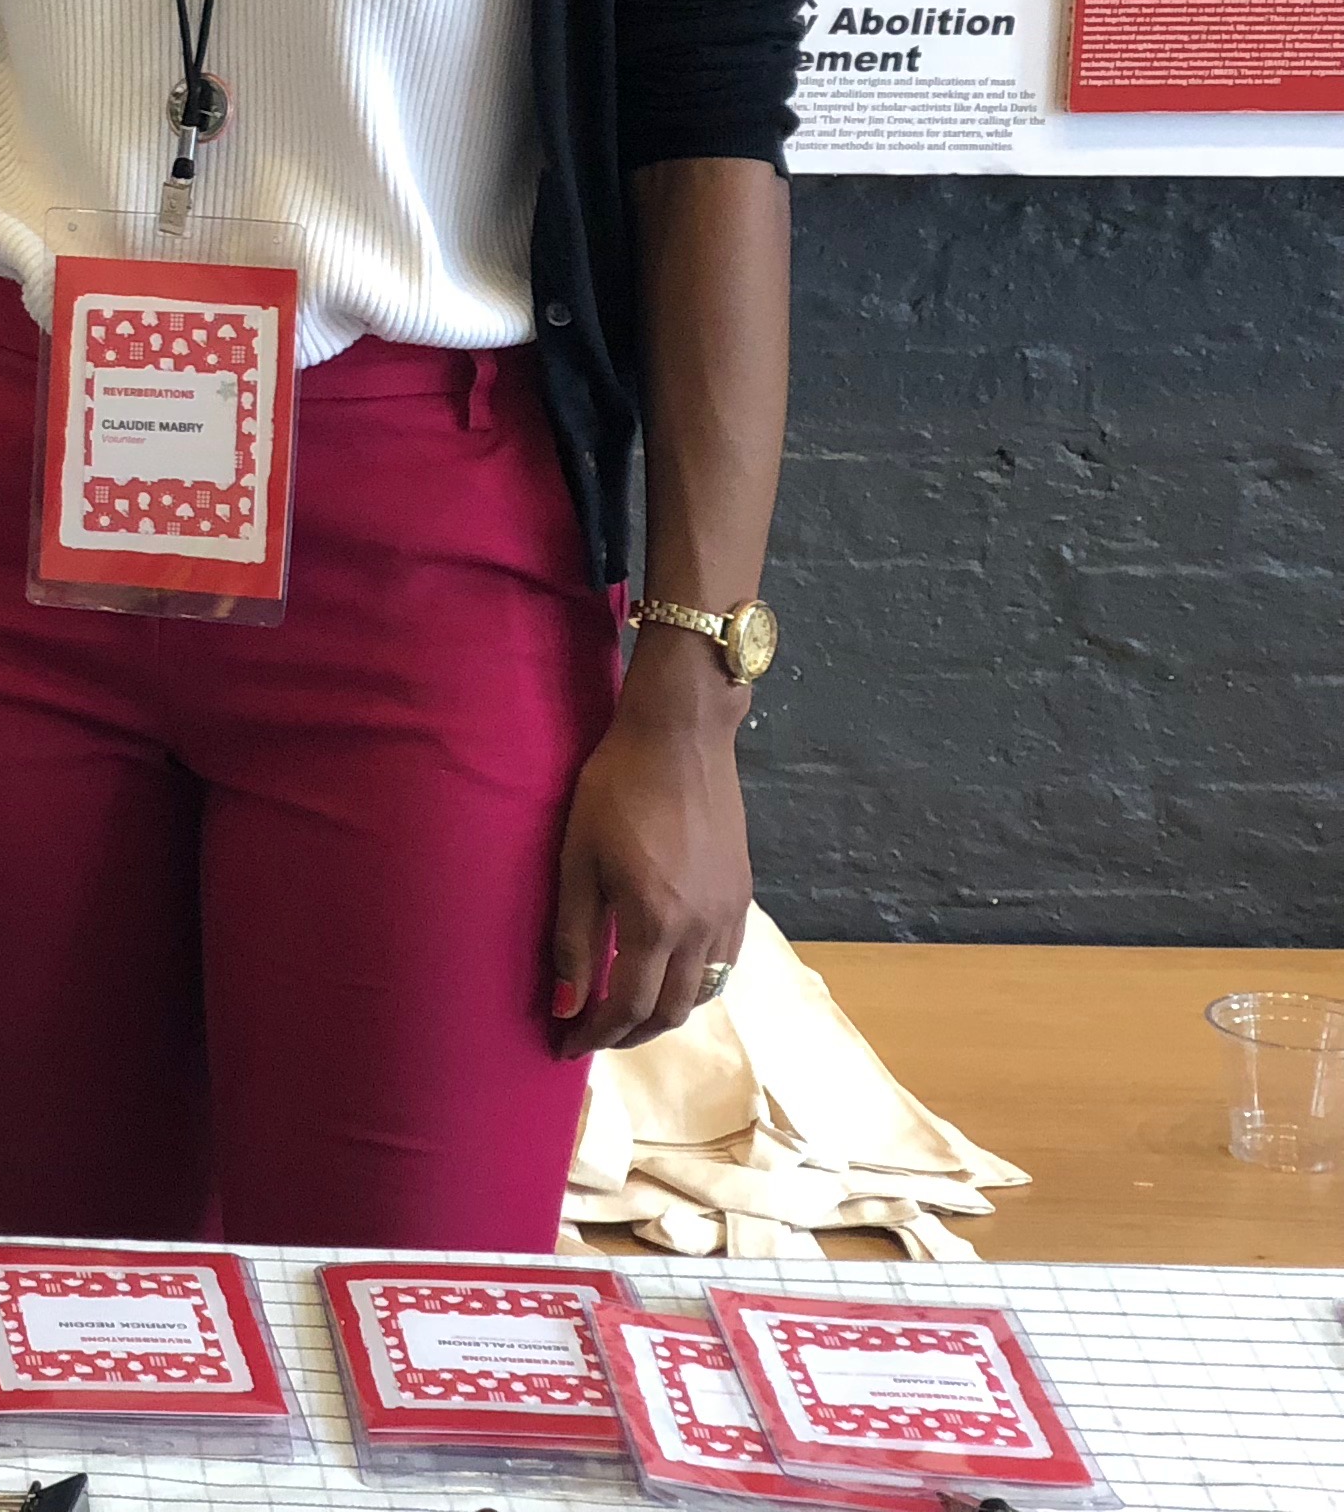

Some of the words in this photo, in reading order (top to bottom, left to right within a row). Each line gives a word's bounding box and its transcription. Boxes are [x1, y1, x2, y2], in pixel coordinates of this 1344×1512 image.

[828, 8, 1015, 35] Abolition
[796, 47, 921, 74] ement
[102, 387, 195, 400] REVERBERATIONS
[102, 419, 156, 432] CLAUDIE
[159, 421, 204, 434] MABRY
